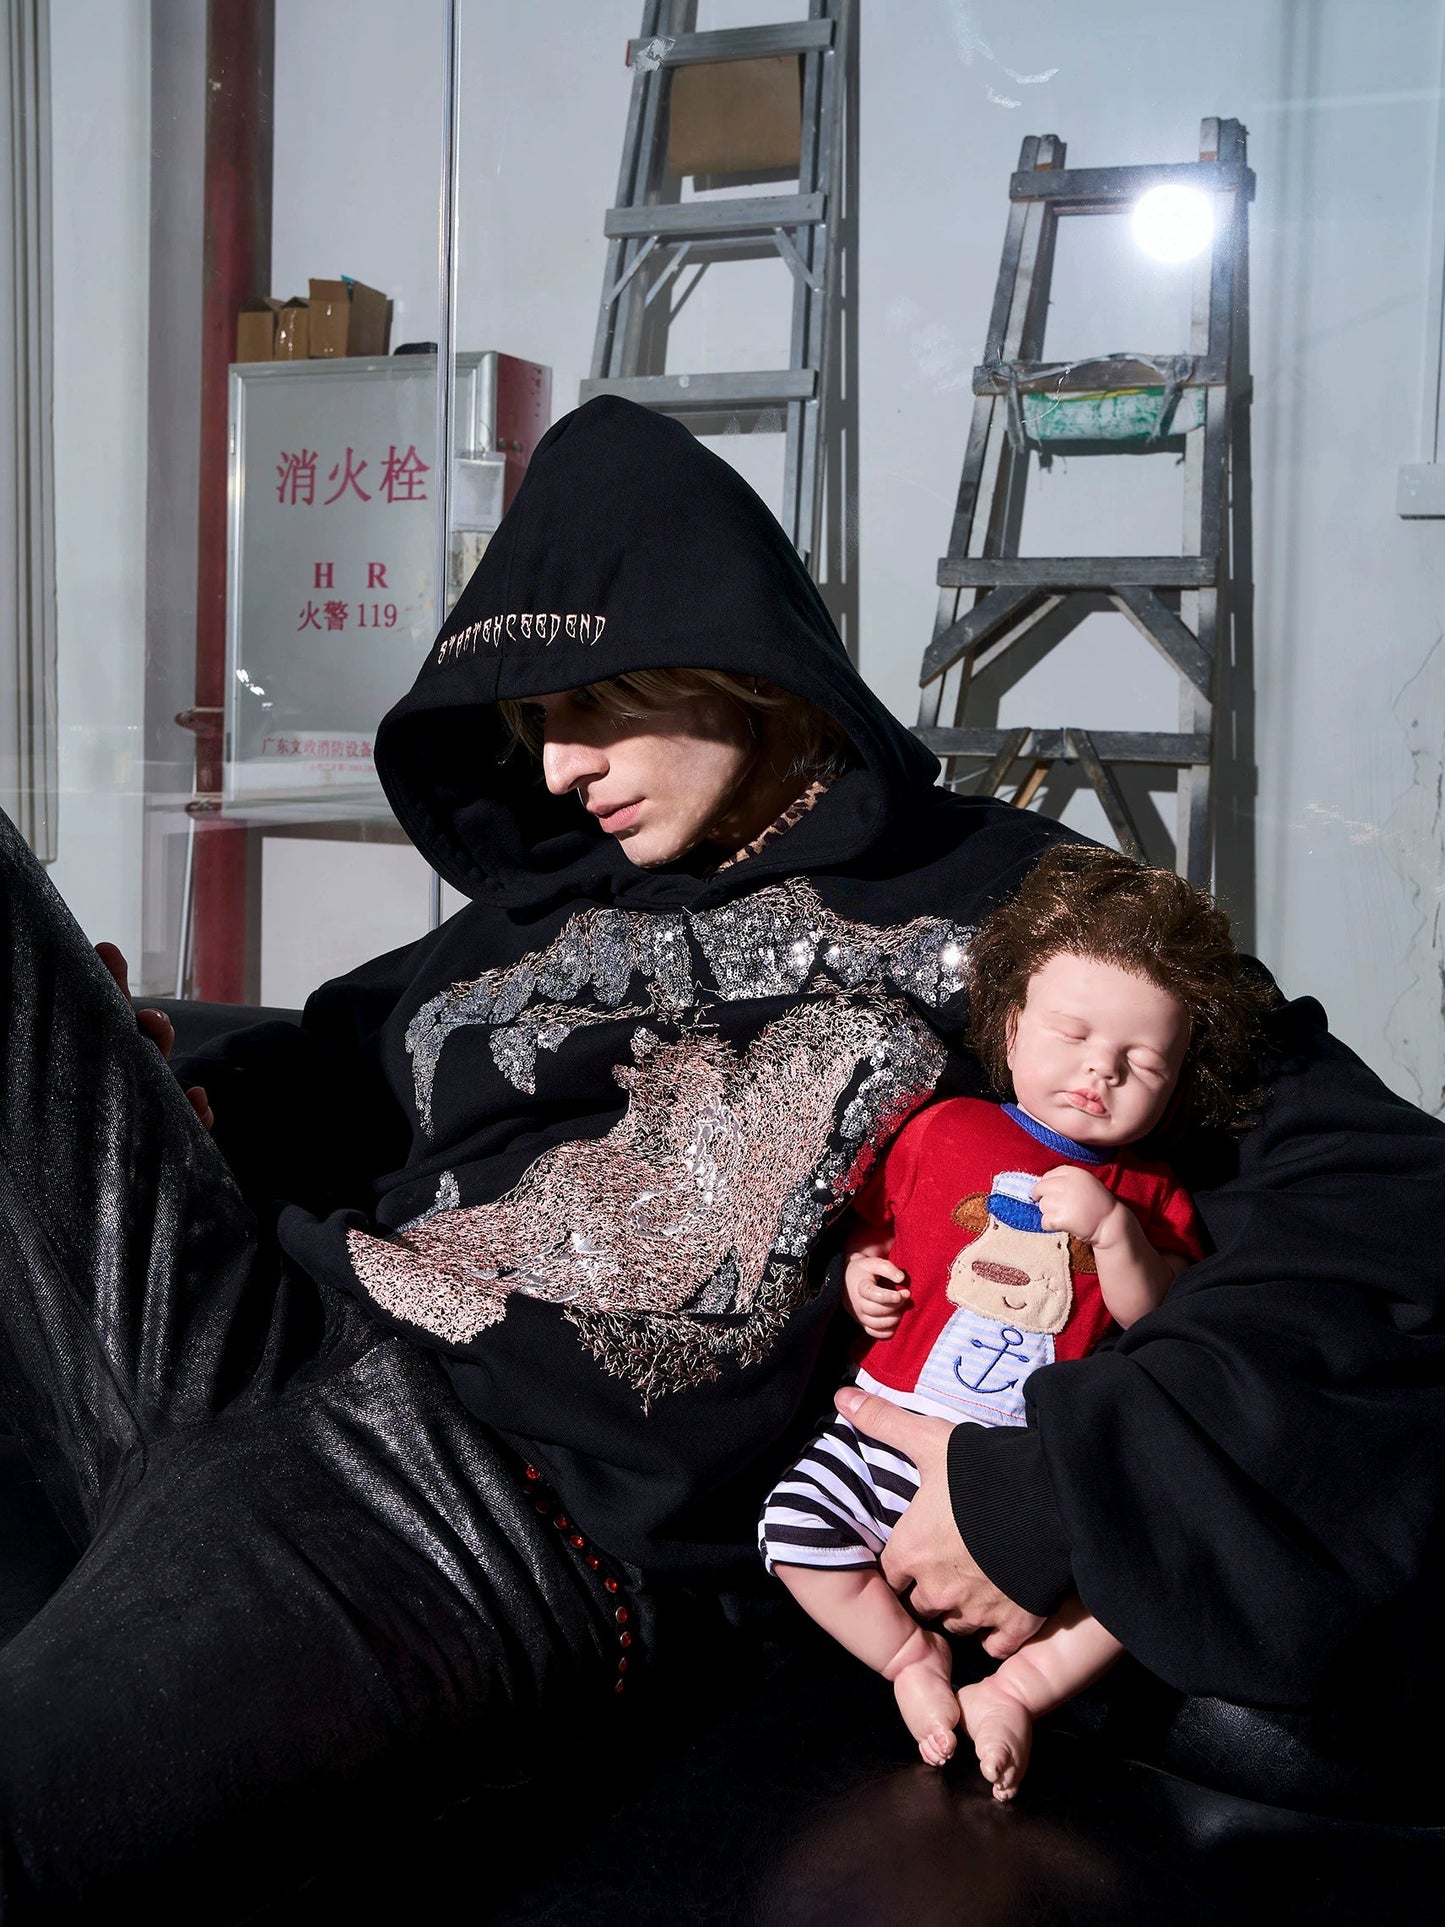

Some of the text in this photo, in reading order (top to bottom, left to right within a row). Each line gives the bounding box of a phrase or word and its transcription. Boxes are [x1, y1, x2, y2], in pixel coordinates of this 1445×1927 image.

[276, 445, 431, 506] 消火栓
[313, 562, 389, 589] H R
[297, 601, 398, 631] 火警 119
